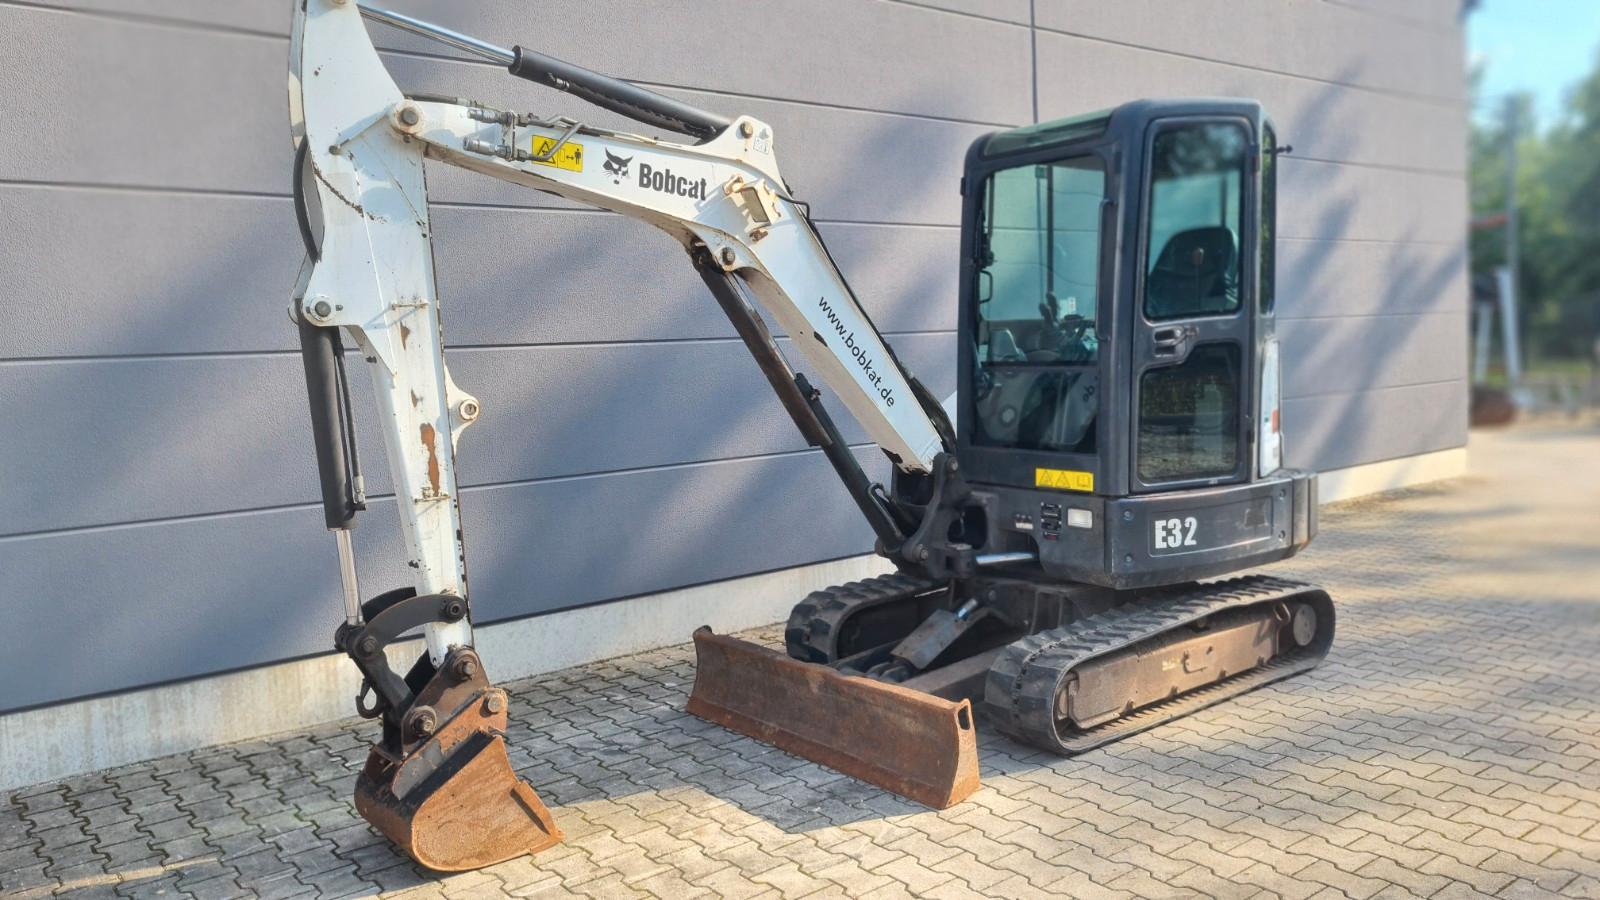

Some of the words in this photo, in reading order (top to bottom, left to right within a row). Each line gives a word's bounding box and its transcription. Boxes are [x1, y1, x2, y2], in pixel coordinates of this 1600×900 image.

[639, 163, 706, 200] Bobcat
[819, 297, 894, 407] www.bobkat.de
[1155, 517, 1197, 548] E32
